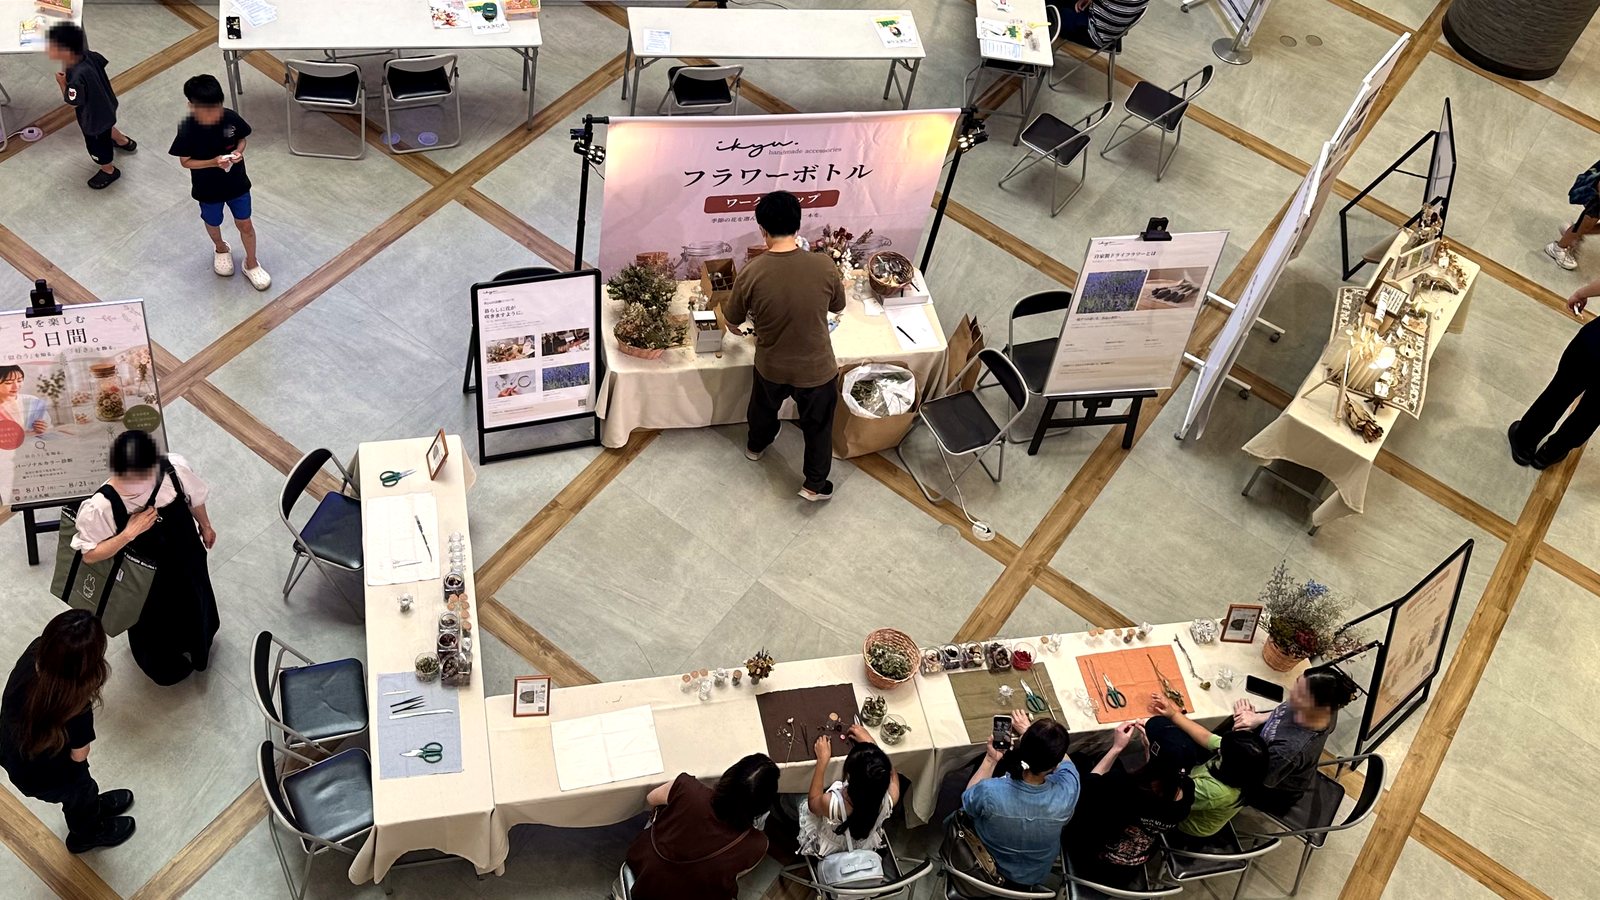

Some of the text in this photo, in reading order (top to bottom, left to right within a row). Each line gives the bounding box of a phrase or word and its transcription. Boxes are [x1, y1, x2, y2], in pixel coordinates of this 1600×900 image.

[683, 163, 874, 188] フラワーボトル
[726, 193, 822, 209] ワークップ
[21, 315, 86, 329] 私を楽しむ
[22, 328, 99, 350] 5日間。
